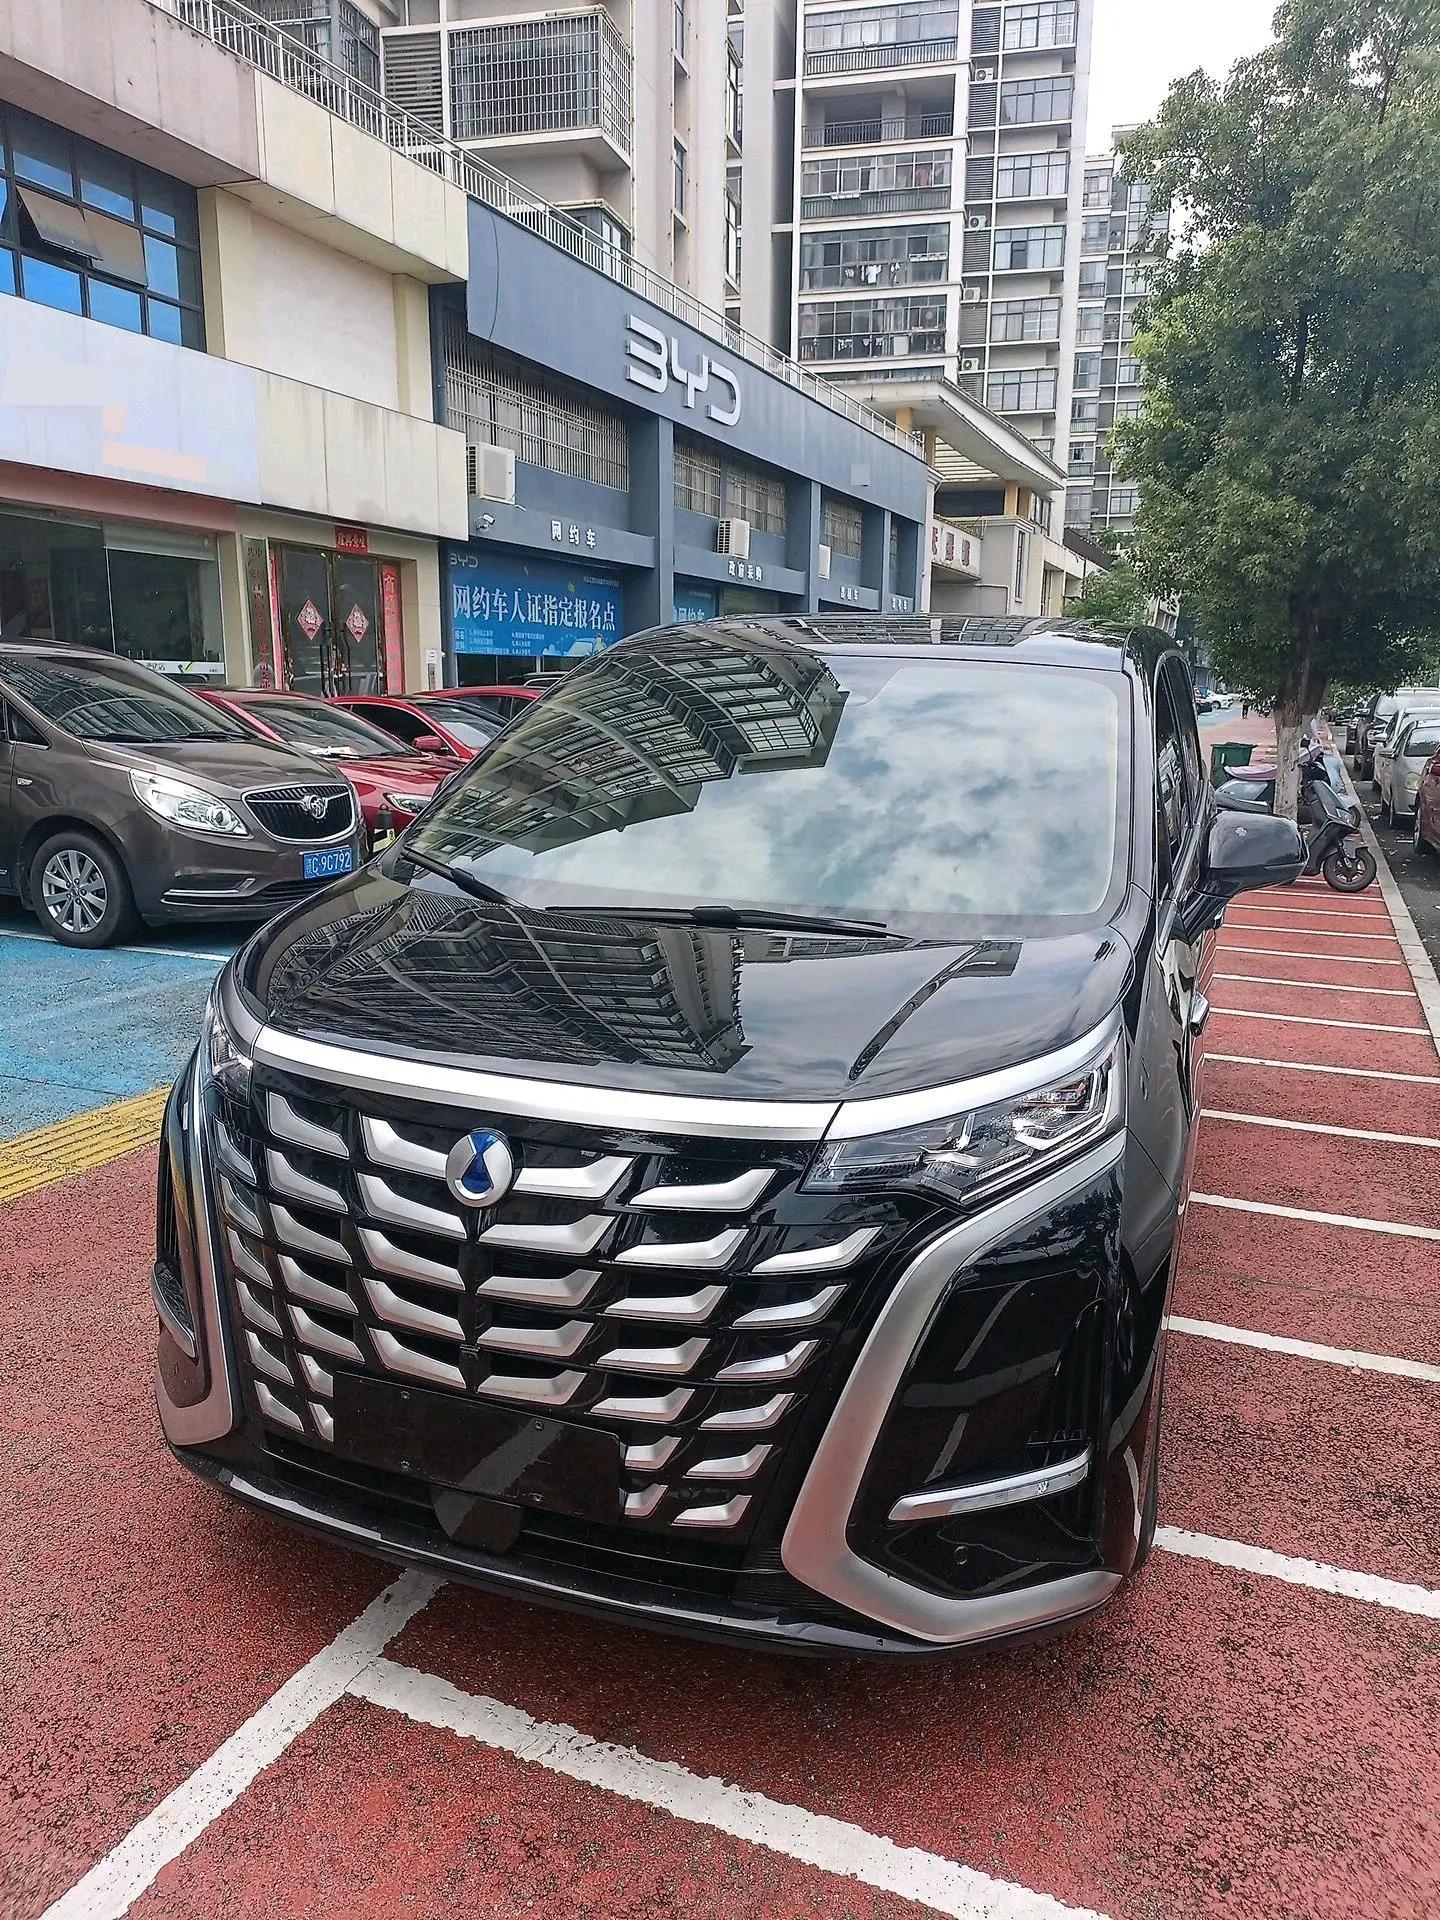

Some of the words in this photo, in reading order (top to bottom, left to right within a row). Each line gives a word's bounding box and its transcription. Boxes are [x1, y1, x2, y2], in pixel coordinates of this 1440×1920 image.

[626, 314, 742, 427] BYD
[551, 519, 596, 549] 网约车
[450, 552, 479, 568] BYD
[728, 560, 763, 582] 政府采购
[452, 583, 616, 632] 网约车人证指定报名点
